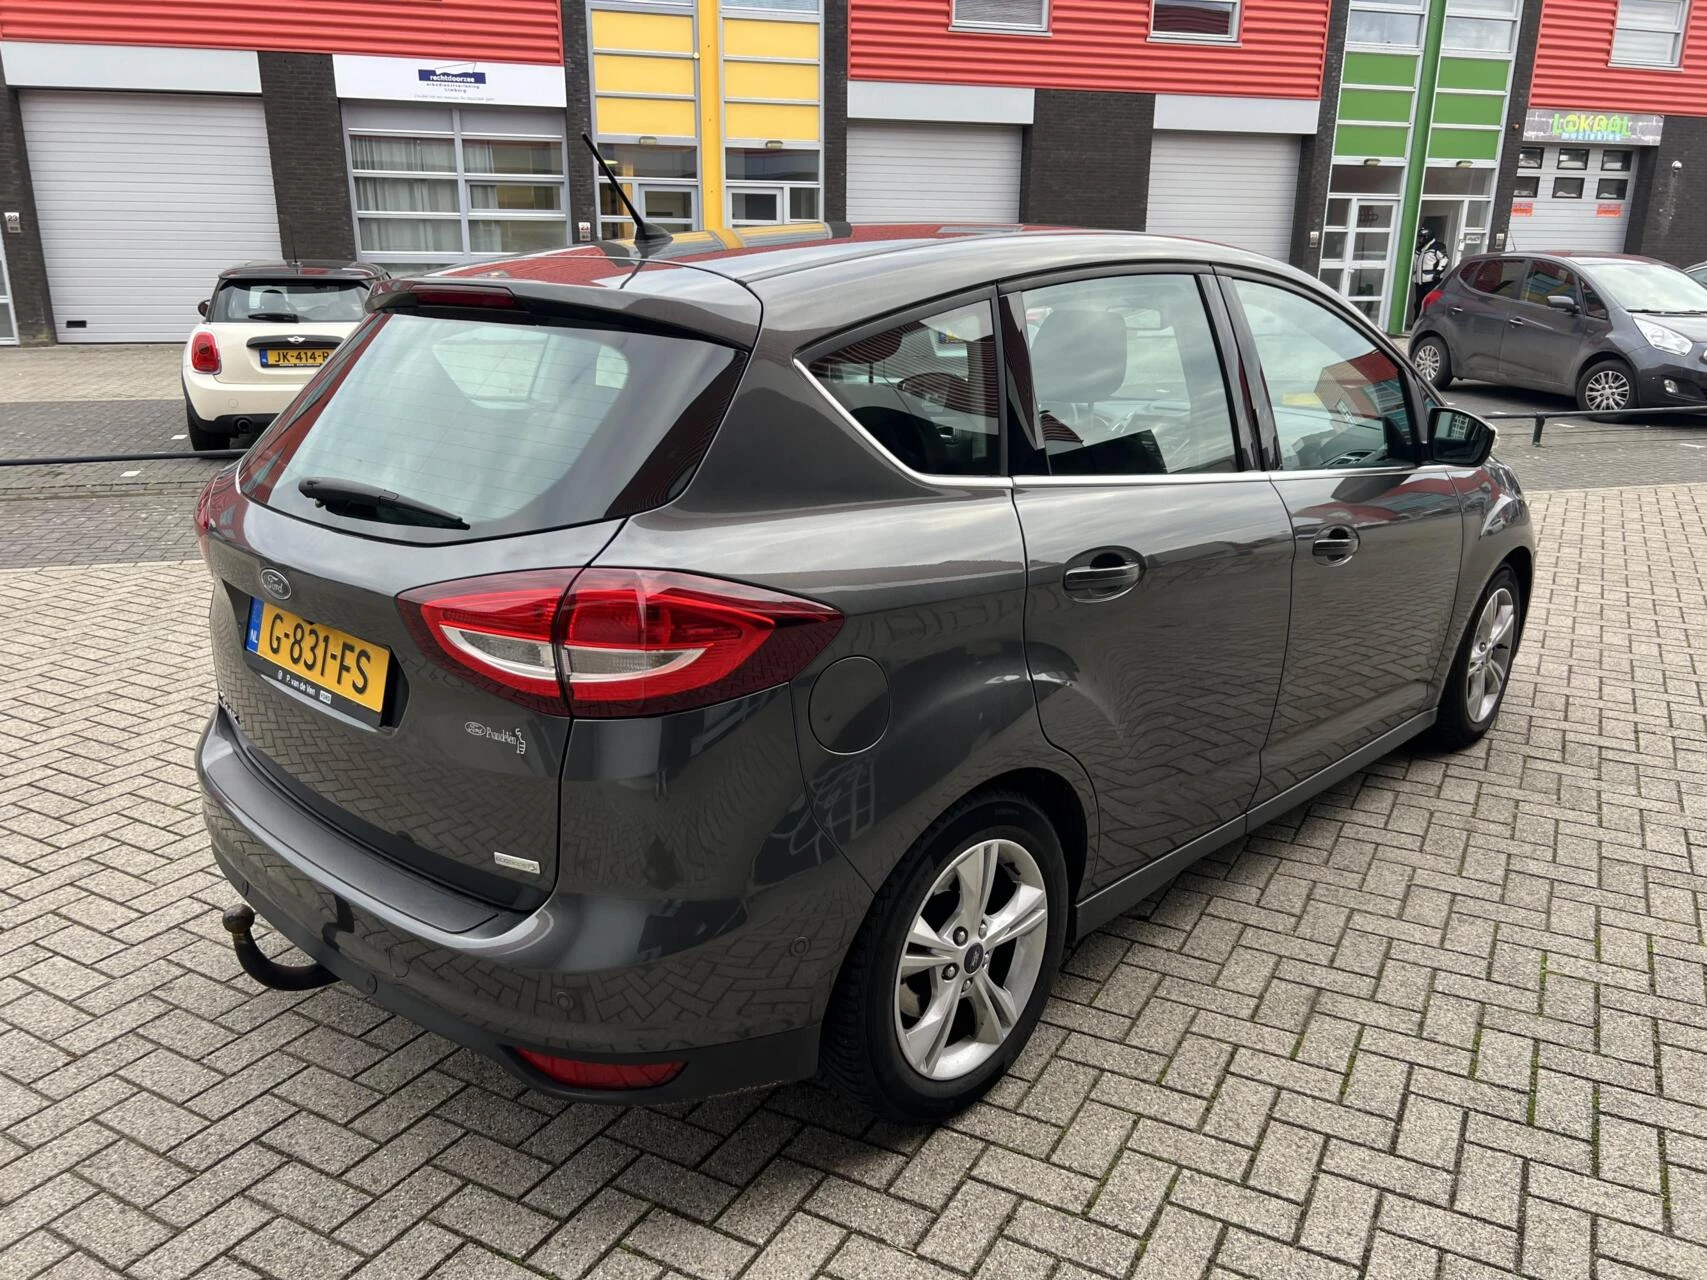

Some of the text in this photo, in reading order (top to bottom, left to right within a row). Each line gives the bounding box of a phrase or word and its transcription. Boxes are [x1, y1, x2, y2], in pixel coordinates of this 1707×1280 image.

[430, 75, 475, 83] rechtdoorzee
[250, 630, 259, 643] NL
[269, 612, 371, 695] G-831-FS
